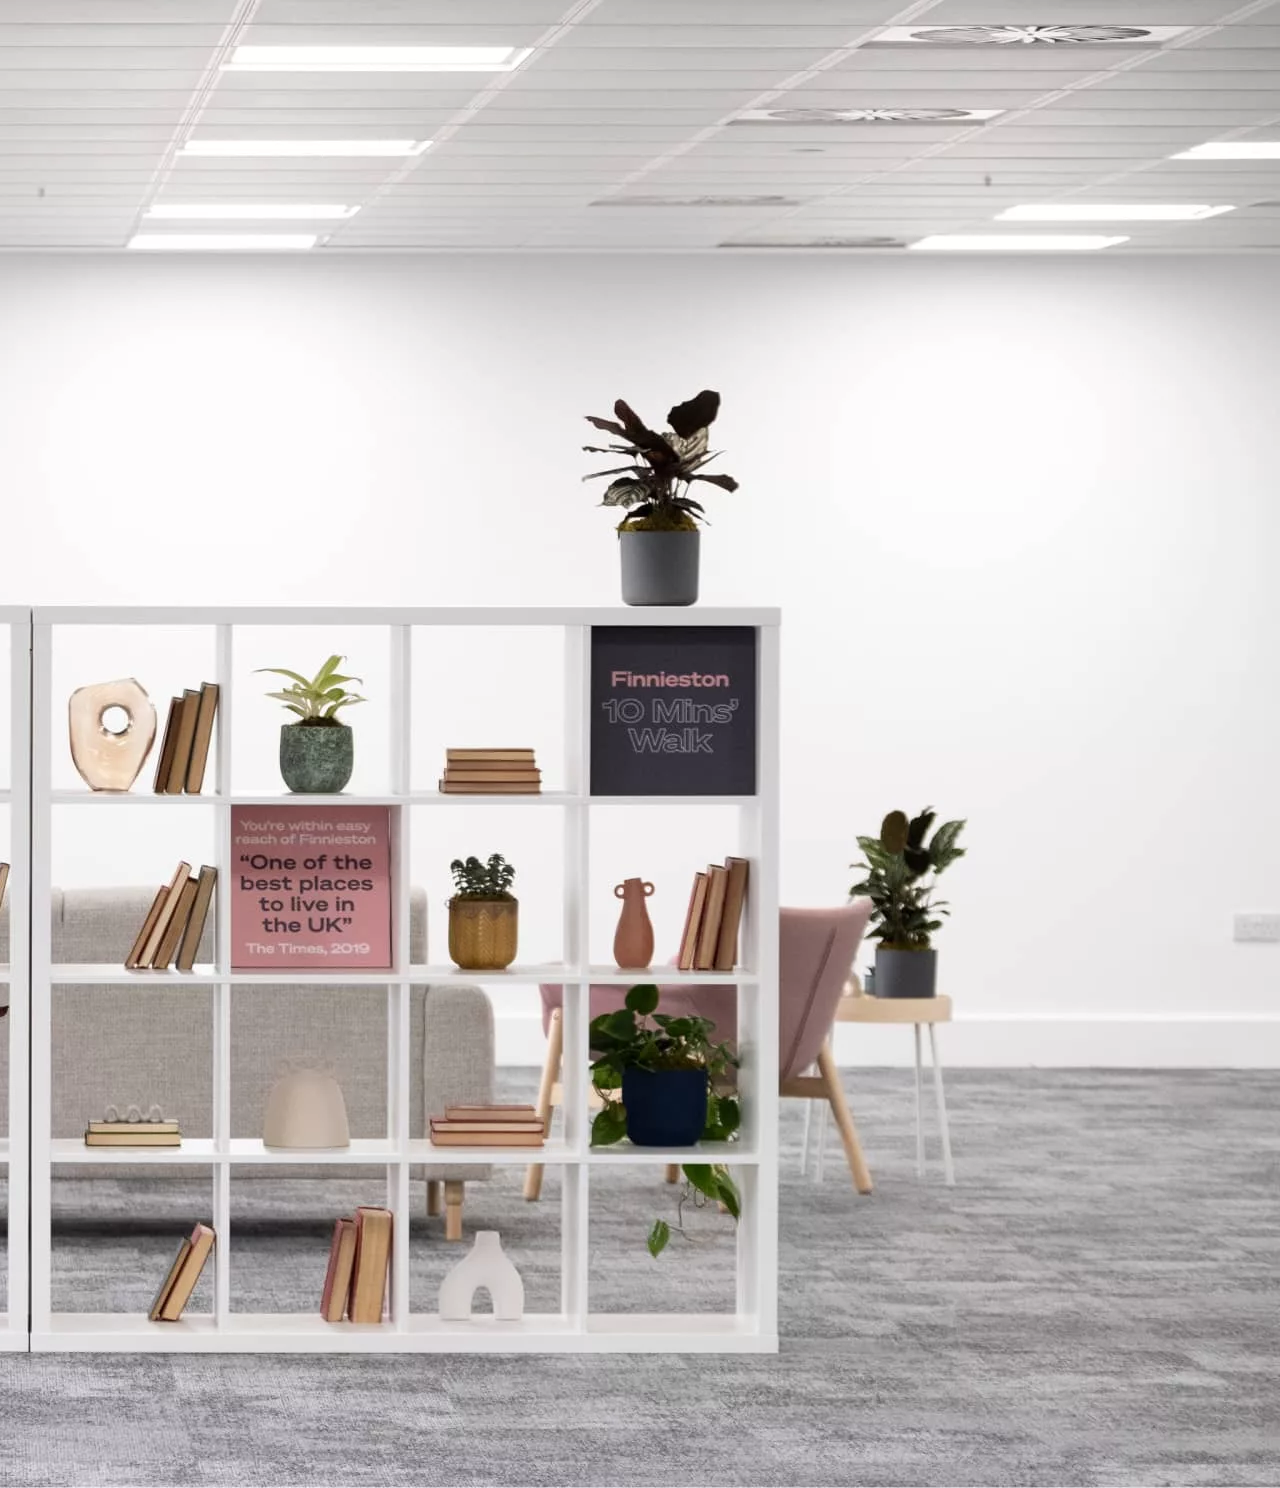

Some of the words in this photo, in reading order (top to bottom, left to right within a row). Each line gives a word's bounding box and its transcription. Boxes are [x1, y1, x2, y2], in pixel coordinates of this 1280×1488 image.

[611, 671, 729, 688] Finnieston
[601, 698, 645, 724] 10
[652, 698, 739, 724] Mins’
[628, 728, 714, 754] Walk
[239, 820, 285, 832] You’re
[288, 820, 333, 832] within
[335, 822, 372, 834] easy
[234, 834, 277, 845] reach
[280, 834, 297, 845] of
[299, 834, 376, 845] Finnieston
[240, 854, 297, 871] “One
[303, 854, 328, 871] of
[333, 855, 373, 871] the
[240, 875, 293, 891] best
[299, 875, 374, 894] places
[258, 897, 285, 912] to
[291, 896, 329, 912] live
[336, 896, 355, 912] in
[262, 917, 302, 933] the
[308, 917, 352, 933] UK”
[246, 943, 275, 955] The
[278, 943, 328, 957] Times,
[330, 943, 371, 955] 2019
